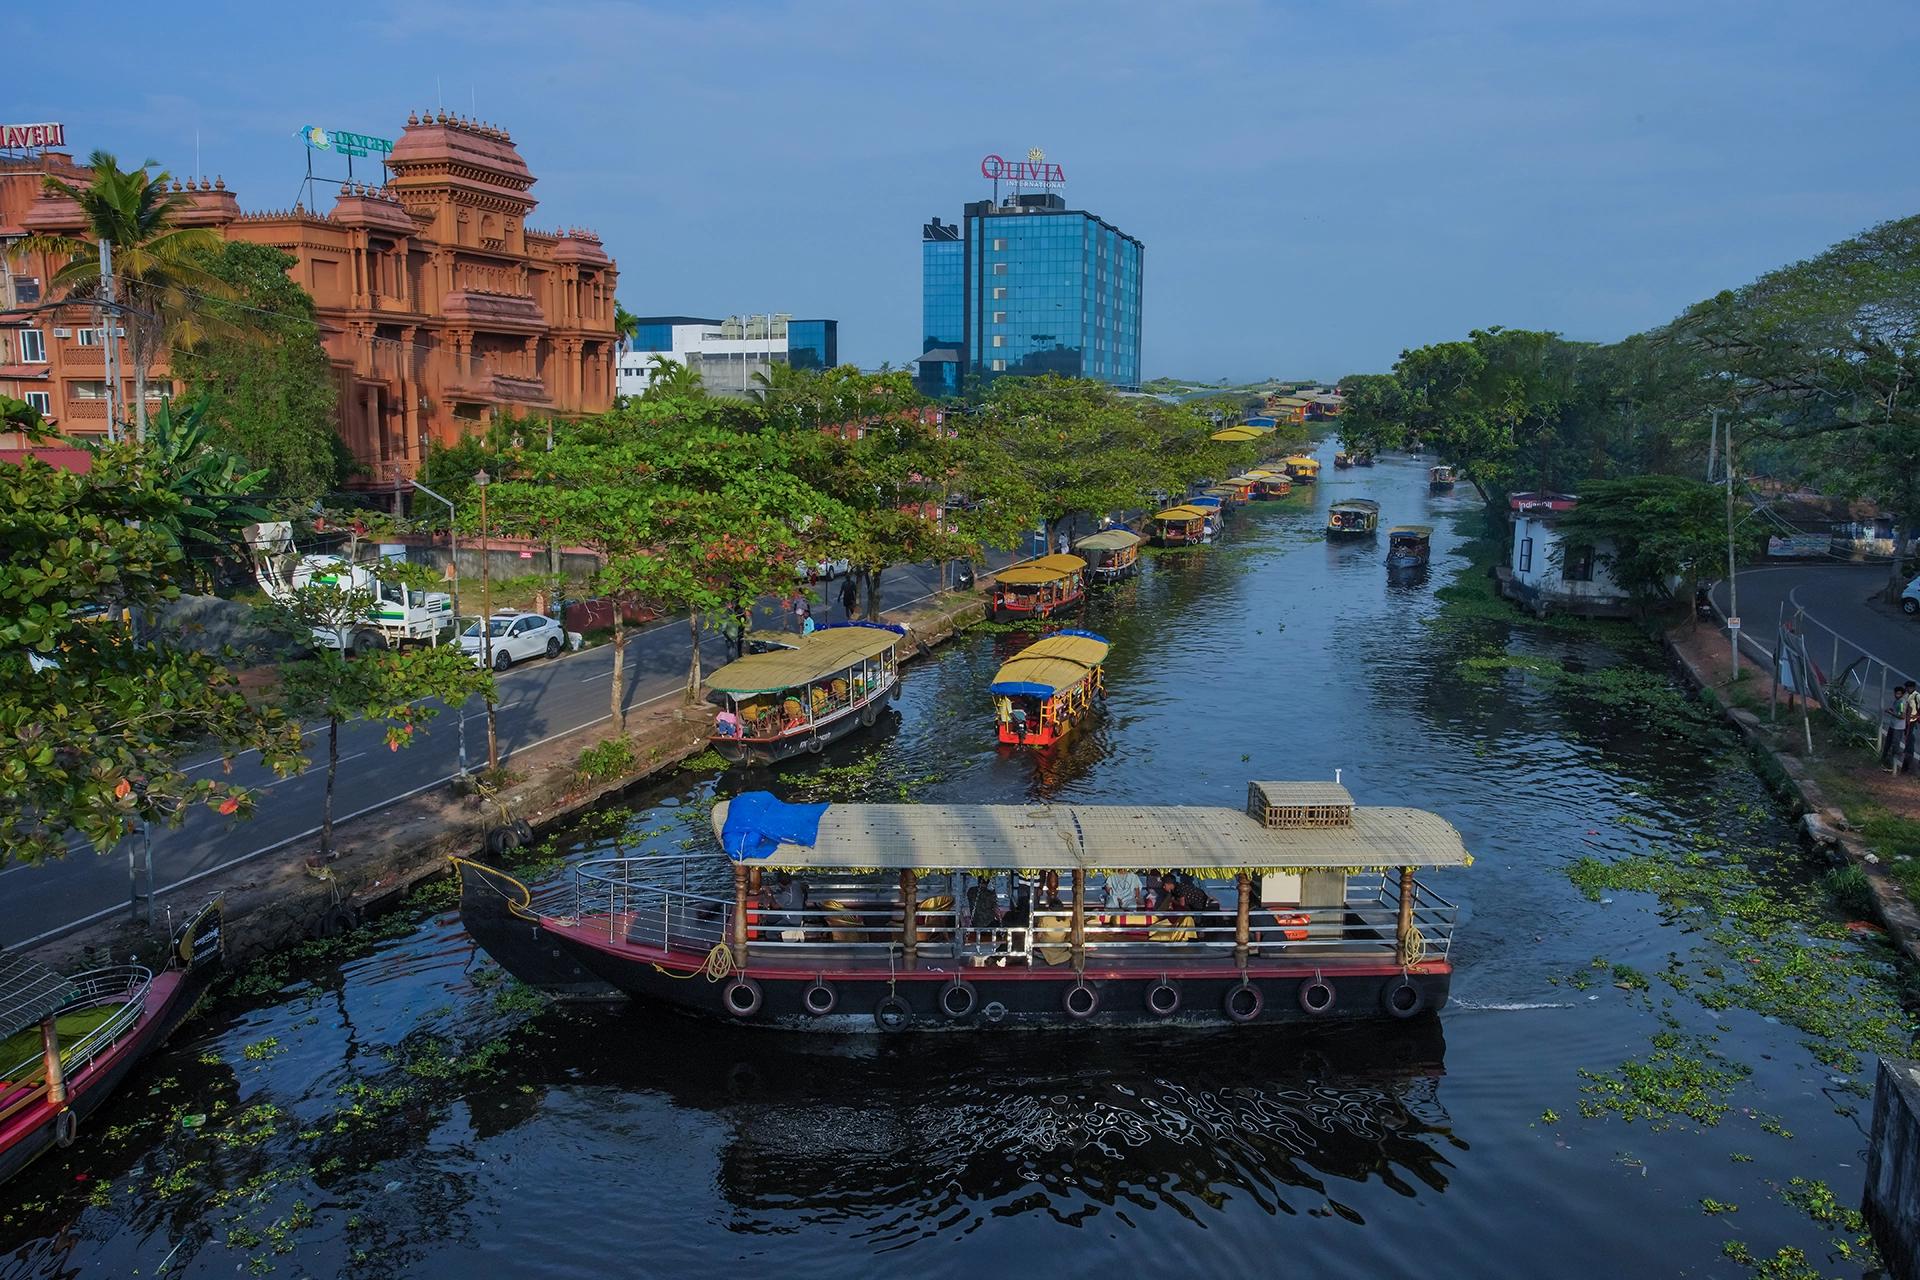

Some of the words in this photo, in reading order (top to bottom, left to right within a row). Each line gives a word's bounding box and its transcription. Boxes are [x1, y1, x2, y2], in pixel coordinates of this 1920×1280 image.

[335, 131, 393, 153] OXYGEN
[981, 155, 1066, 182] OLIVIA
[1005, 179, 1066, 188] INTERNATIONAL
